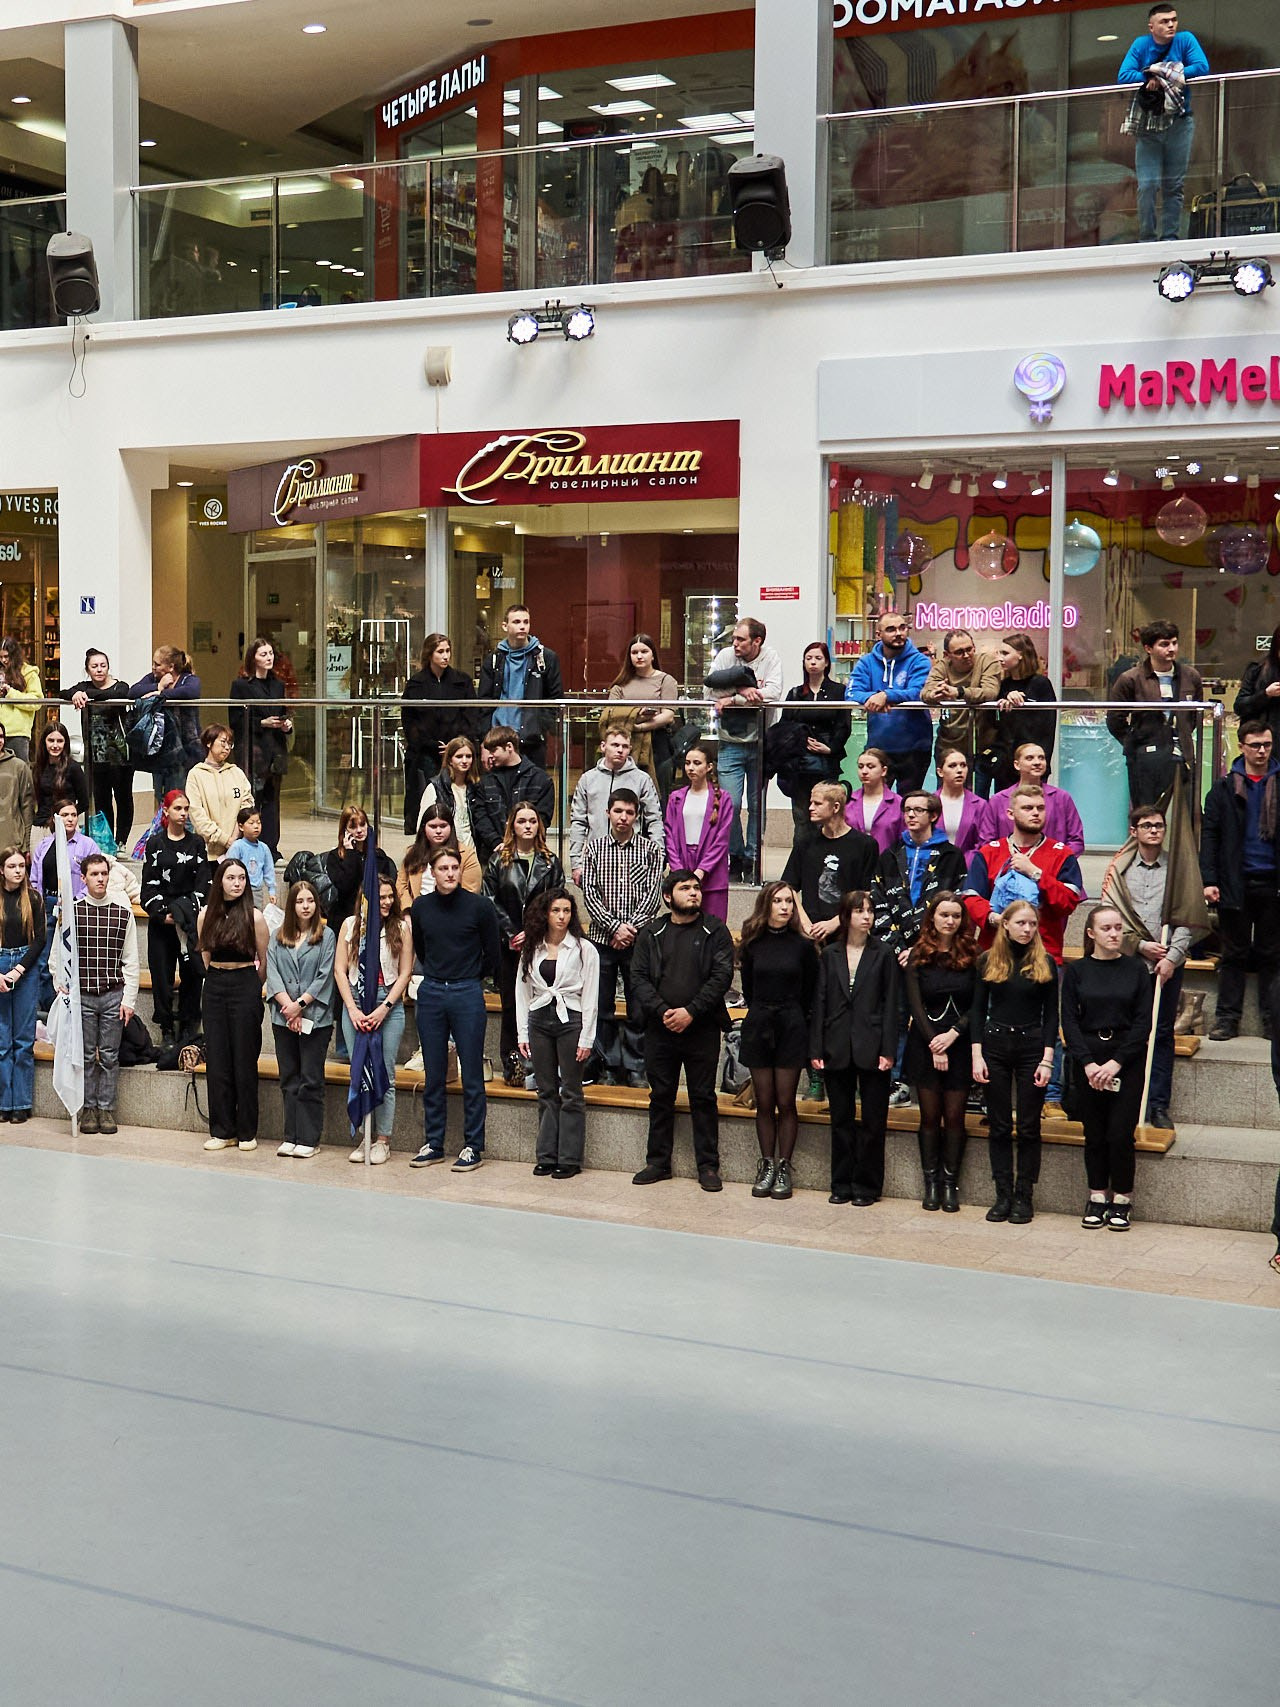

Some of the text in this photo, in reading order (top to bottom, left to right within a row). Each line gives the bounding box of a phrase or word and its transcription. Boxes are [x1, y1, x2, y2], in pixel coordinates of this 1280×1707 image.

[382, 55, 485, 129] ЧЕТЫРЕ ЛАПЫ
[1249, 225, 1267, 233] SPORT
[440, 430, 703, 494] Бриллиант
[271, 459, 355, 522] Бриллиант
[549, 475, 697, 490] ювелирный салон
[6, 495, 40, 513] YVES
[233, 787, 241, 799] B
